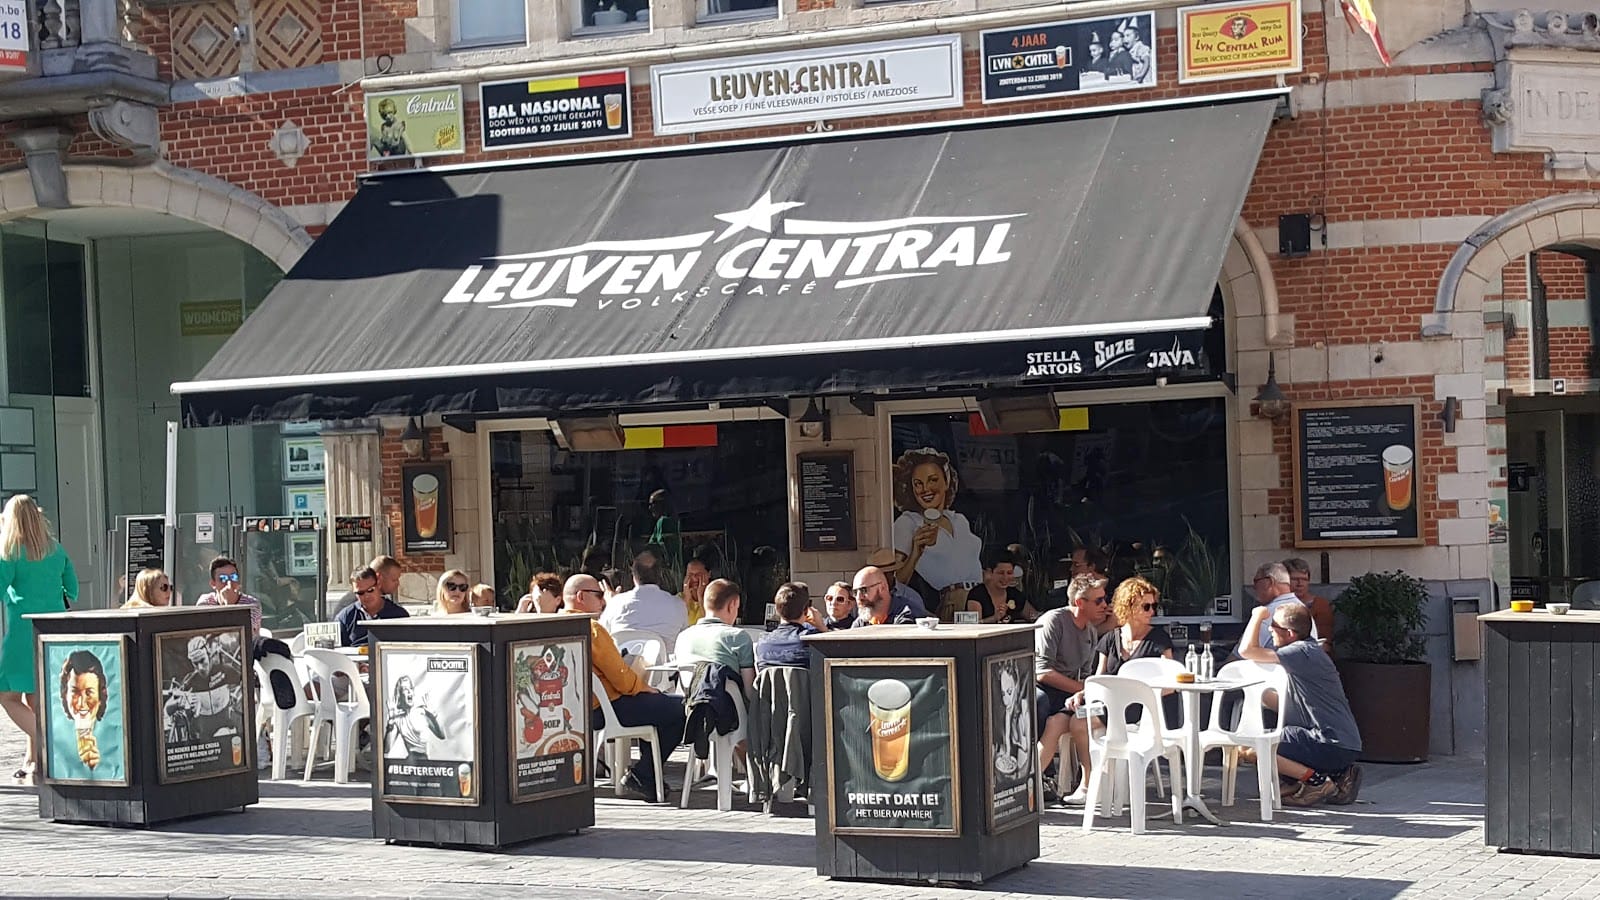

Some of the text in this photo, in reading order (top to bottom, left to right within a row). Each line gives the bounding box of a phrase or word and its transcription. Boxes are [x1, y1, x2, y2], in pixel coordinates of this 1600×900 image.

[1012, 33, 1047, 48] 4 JAAR
[992, 57, 1012, 70] LVN
[710, 59, 891, 102] LEUVEN CENTRAL
[488, 96, 601, 119] BAL NASJONAL
[693, 106, 716, 116] VESSE
[718, 104, 738, 114] SOEP
[768, 96, 820, 109] VLEESWAREN
[826, 91, 865, 103] PISTOLEIS
[489, 119, 506, 128] DOO
[543, 113, 567, 122] OUVER
[489, 119, 603, 138] ZOOTERDAG 20 ZJULIE 2019
[442, 223, 1011, 303] LEUVEN CENTRAL
[1027, 350, 1081, 364] STELLA
[1094, 338, 1135, 368] Suze
[1147, 349, 1196, 369] JAVA
[1027, 362, 1082, 376] ARTOIS
[388, 764, 454, 777] #BLEFTEREWEG
[848, 792, 939, 806] PRIEFT DAT IE!
[855, 808, 932, 819] HET BIER VAN HIER!
